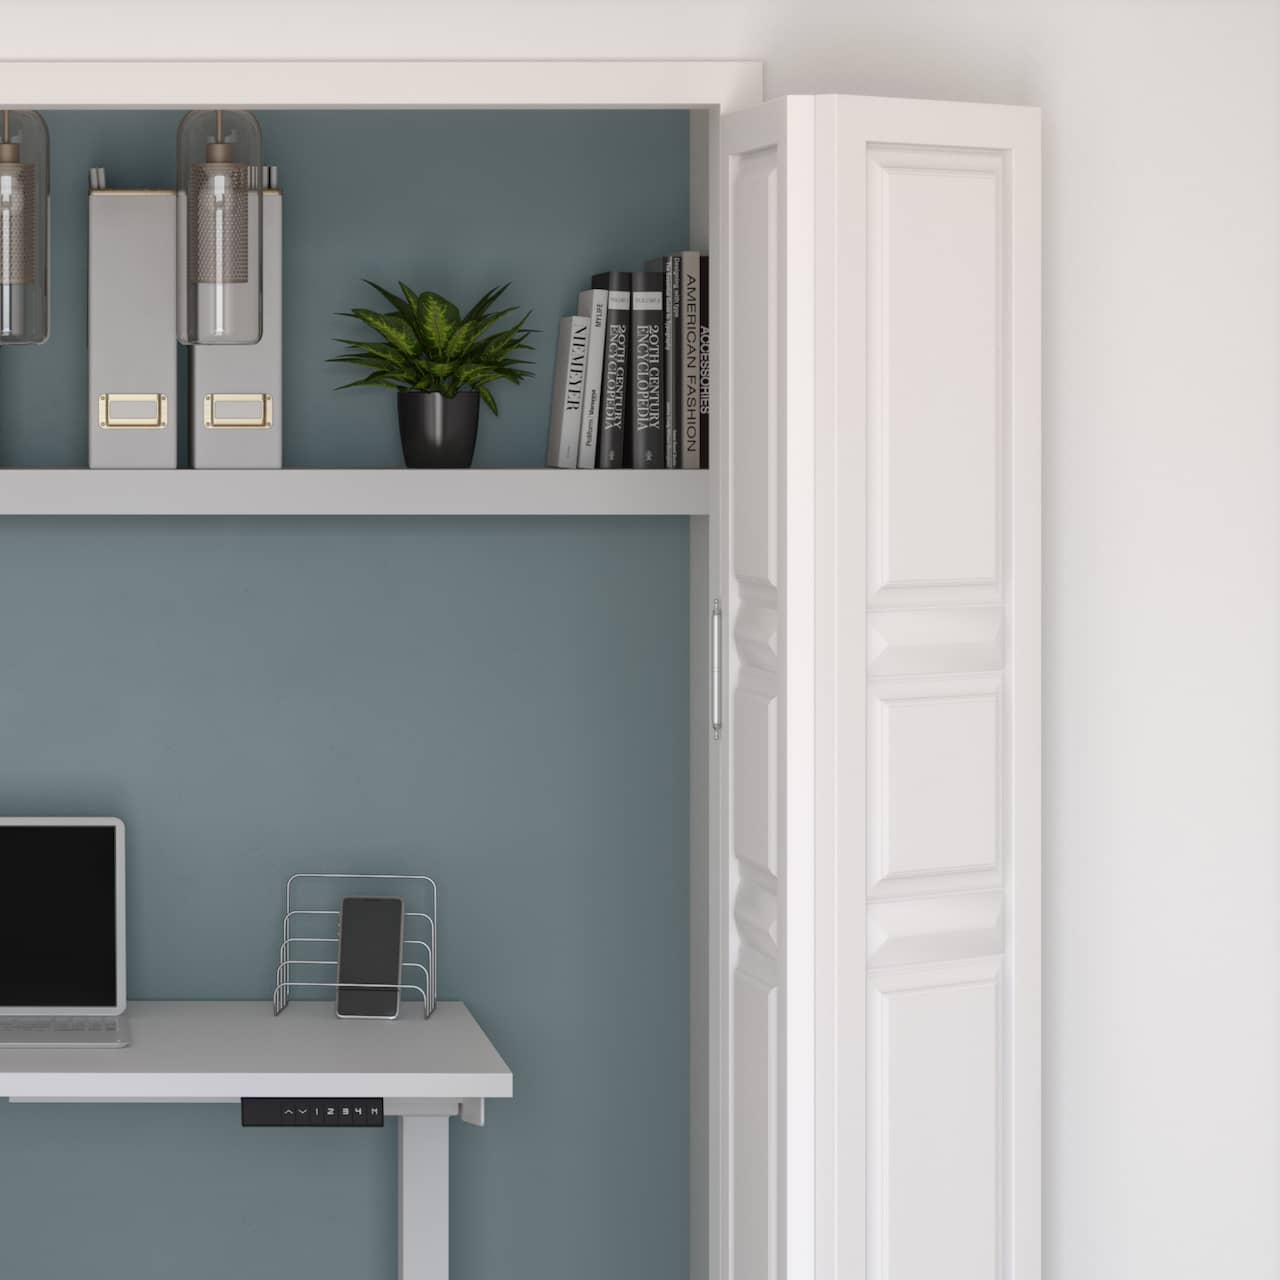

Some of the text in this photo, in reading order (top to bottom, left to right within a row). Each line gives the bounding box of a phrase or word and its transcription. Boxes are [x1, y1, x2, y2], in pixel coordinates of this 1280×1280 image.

[566, 325, 587, 410] NIEMEYER
[604, 325, 620, 430] ENCYCLOPEDIA
[613, 324, 627, 429] 20TH CENTURY
[637, 325, 650, 431] ENCYCLOPEDIA
[648, 324, 660, 430] 20TH CENTURY
[686, 274, 697, 452] AMERICAN FASHION
[700, 327, 710, 414] ACCESSORIES
[327, 1107, 335, 1115] 2
[342, 1107, 350, 1115] 3
[354, 1107, 362, 1115] 4
